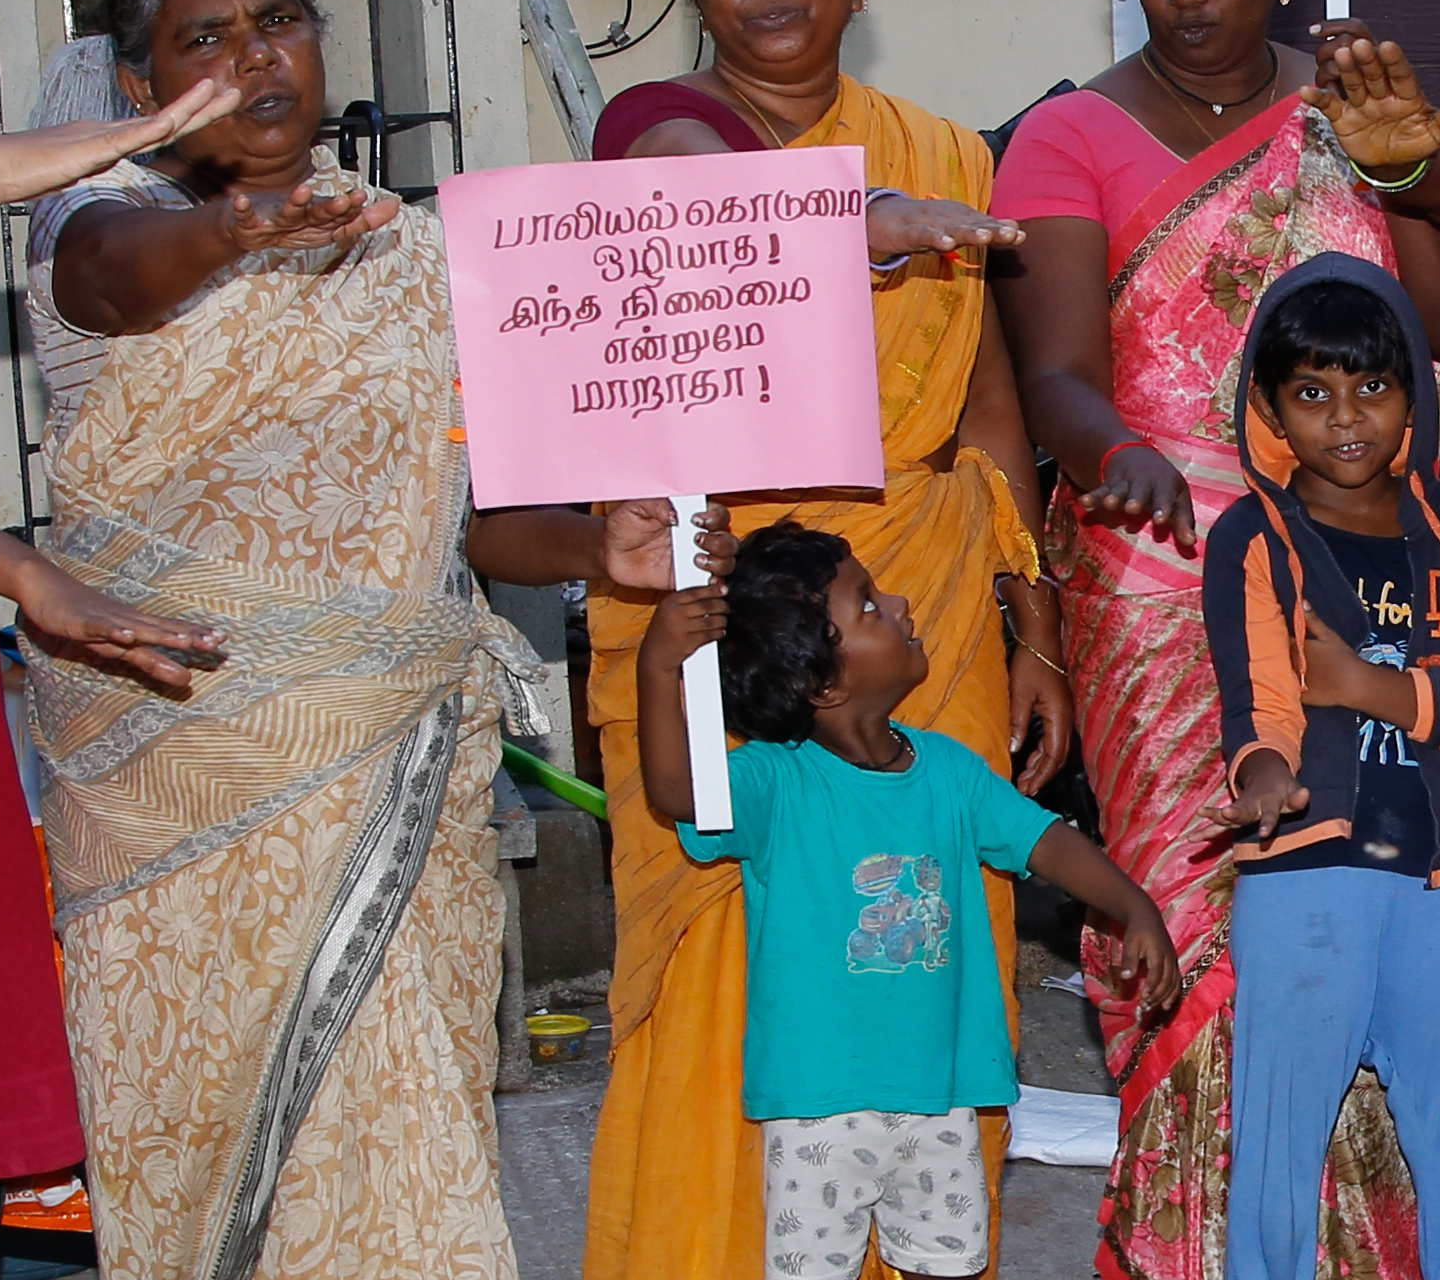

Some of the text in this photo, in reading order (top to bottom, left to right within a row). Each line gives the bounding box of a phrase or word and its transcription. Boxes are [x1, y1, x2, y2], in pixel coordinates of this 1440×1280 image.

[493, 190, 680, 250] பாலியல்
[499, 275, 812, 337] இந்த நிலைமை
[603, 322, 766, 365] என்றுமே
